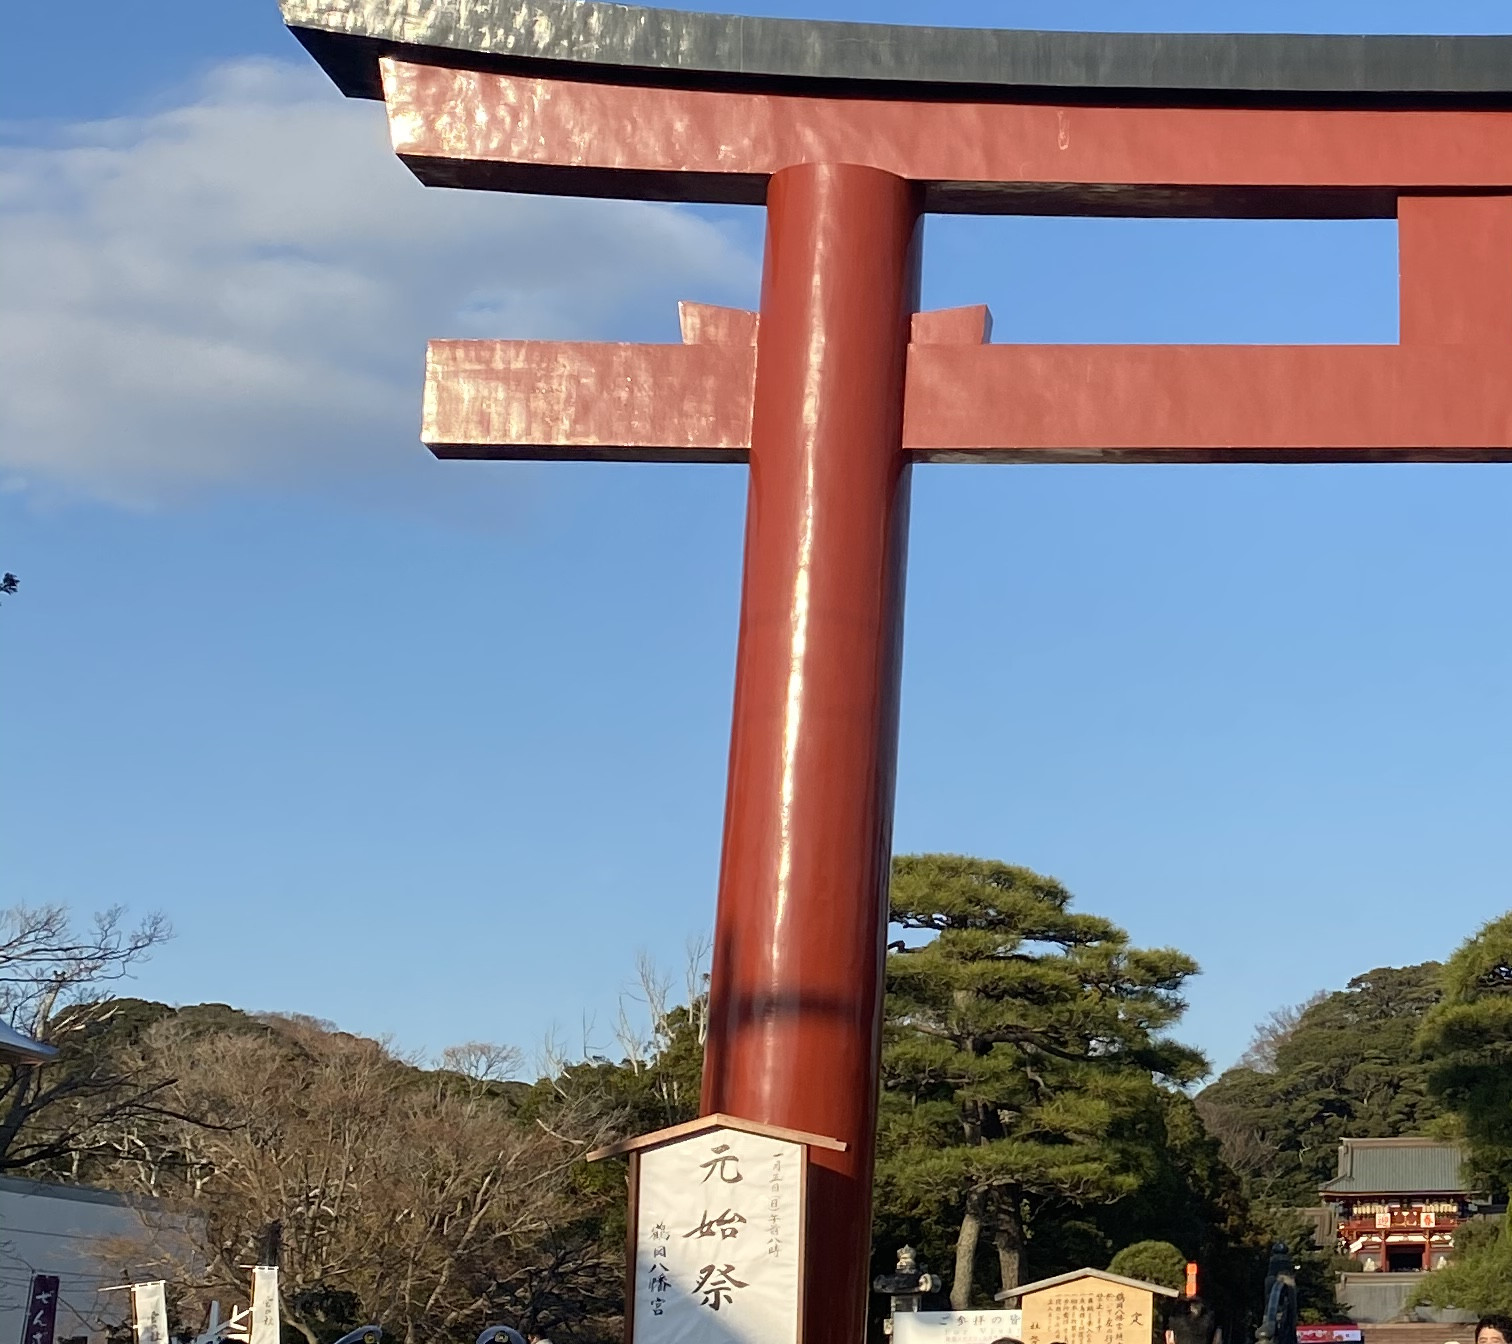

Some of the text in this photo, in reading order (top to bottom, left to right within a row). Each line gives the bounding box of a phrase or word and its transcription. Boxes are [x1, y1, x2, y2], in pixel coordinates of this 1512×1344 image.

[682, 1144, 750, 1311] 元始祭
[1131, 1312, 1144, 1326] 定
